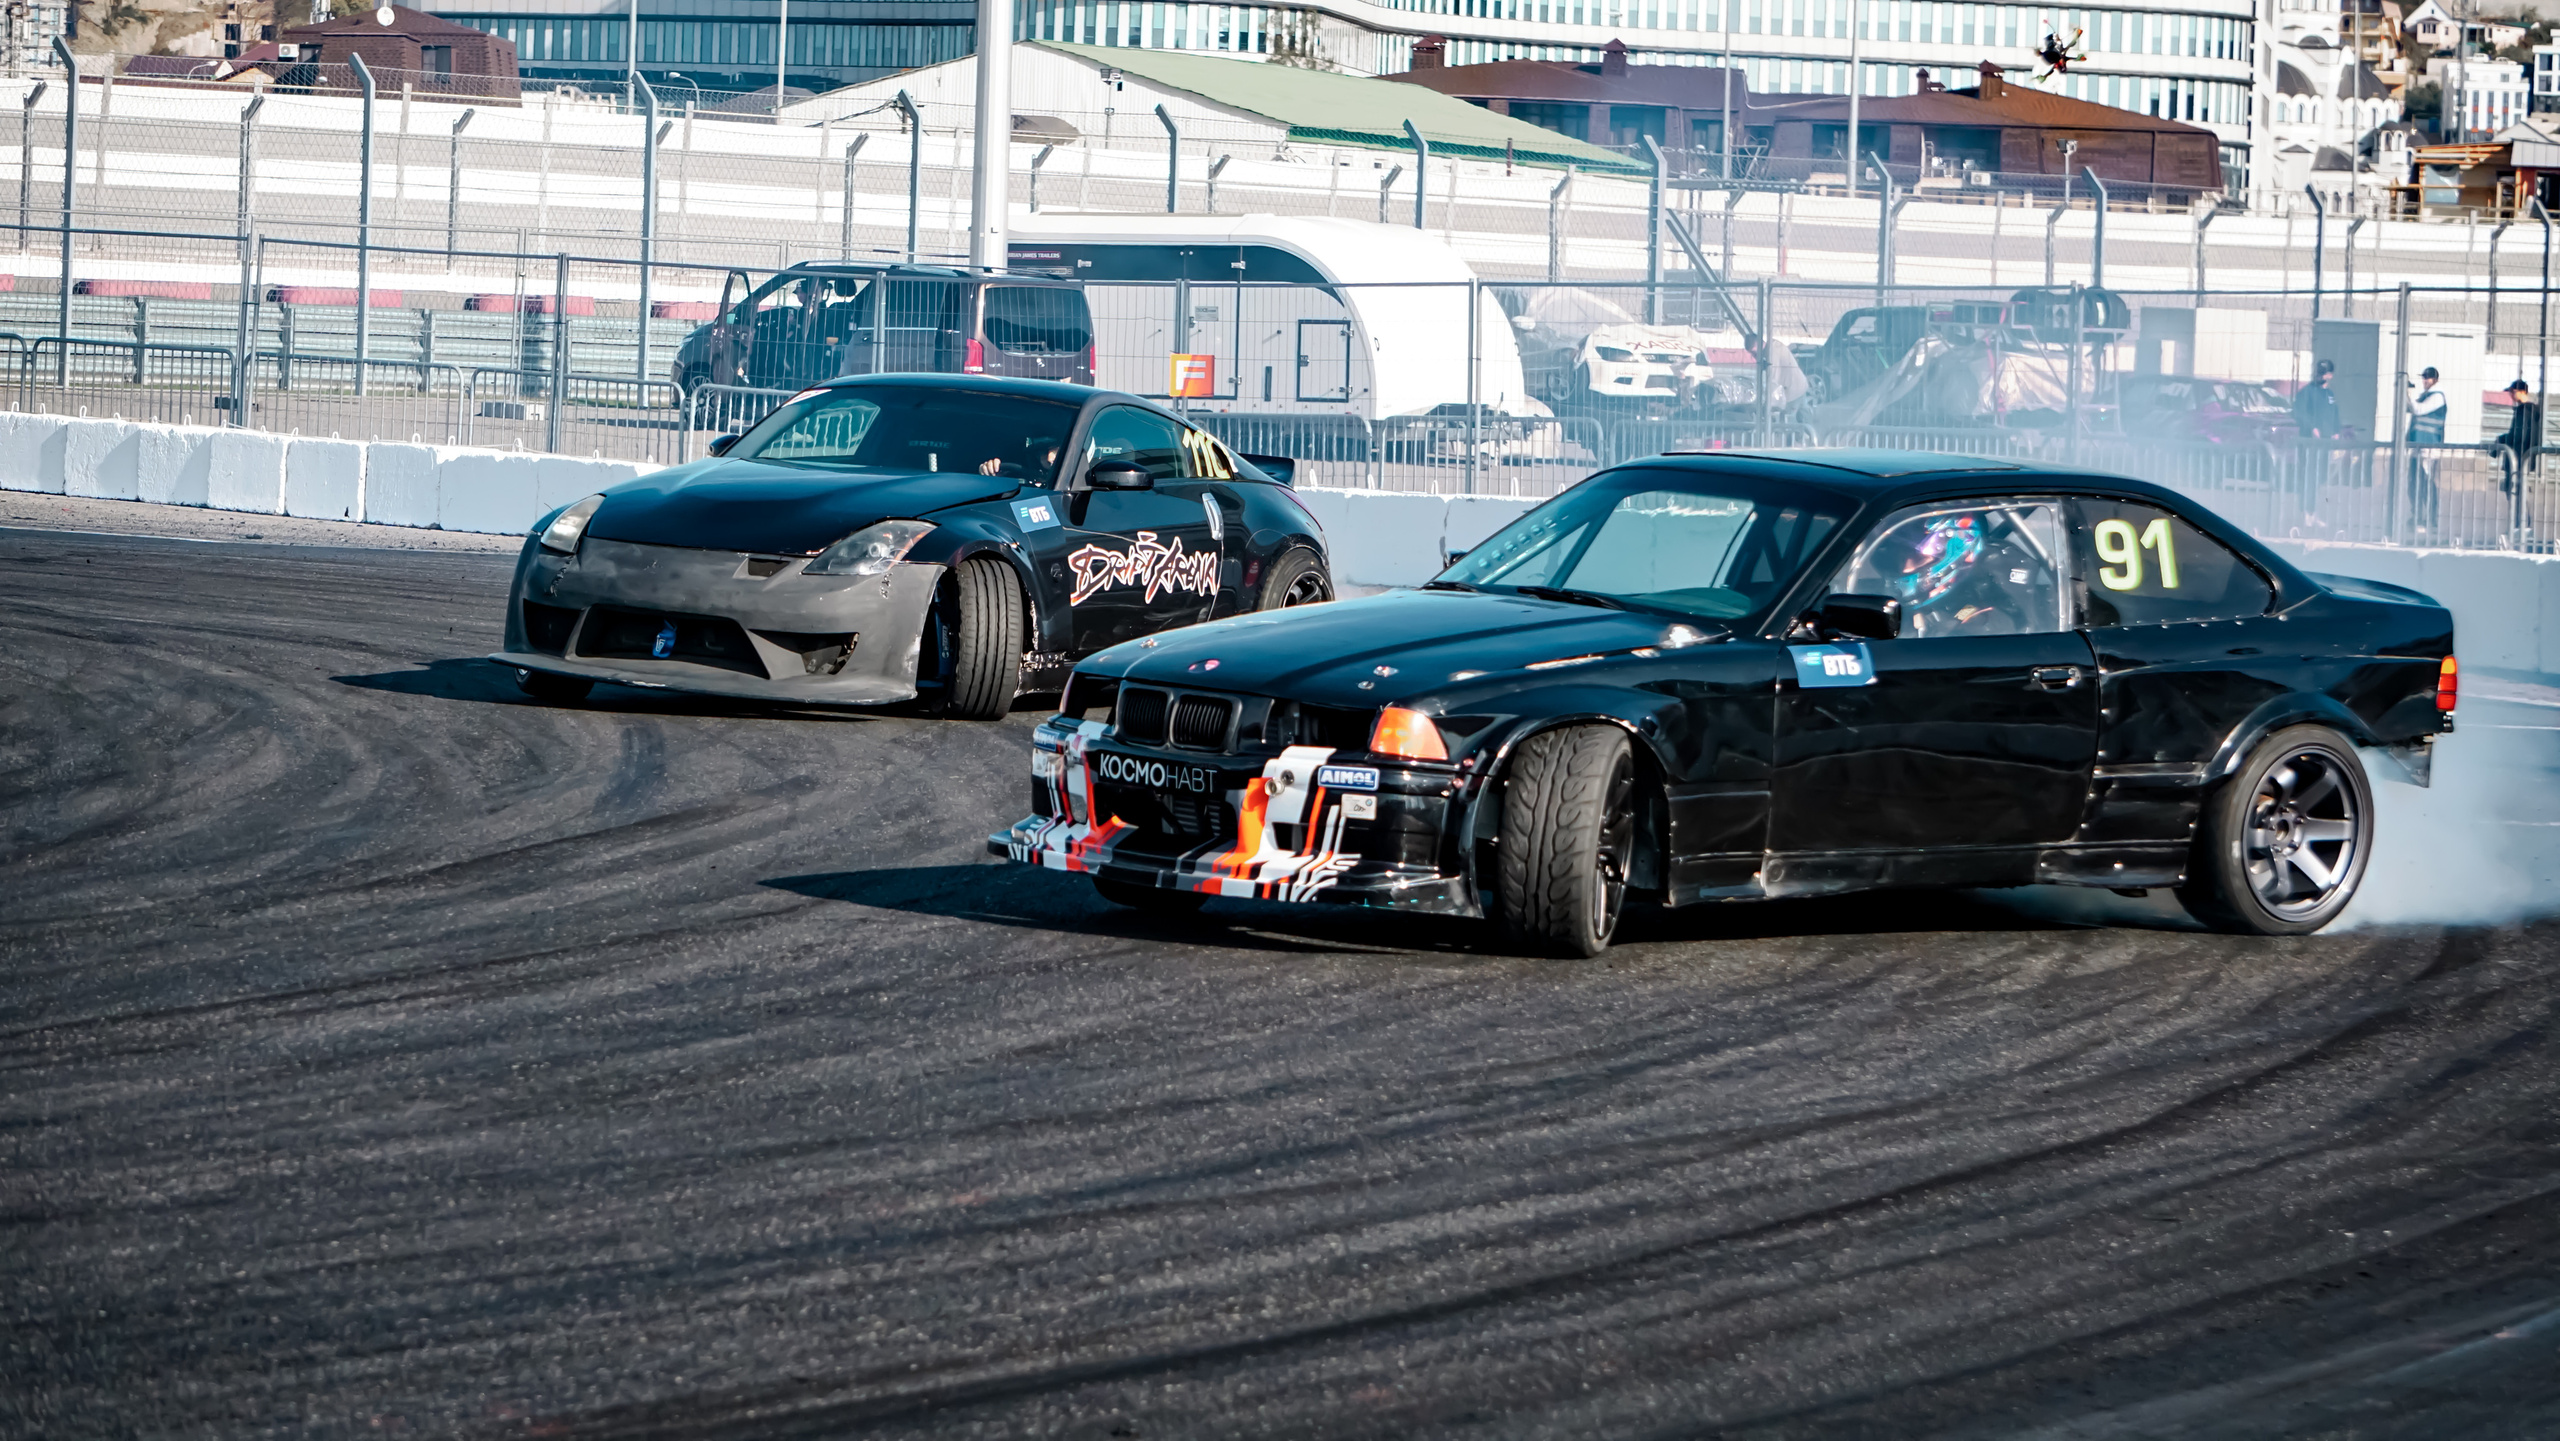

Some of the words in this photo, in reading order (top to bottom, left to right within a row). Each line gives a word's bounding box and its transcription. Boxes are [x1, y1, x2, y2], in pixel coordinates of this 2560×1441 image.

[1175, 360, 1206, 390] F
[1028, 505, 1051, 523] ВТБ
[2094, 518, 2179, 591] 91
[1822, 654, 1862, 676] ВТБ
[1099, 753, 1218, 793] КОСМОНАВТ
[1320, 769, 1375, 786] AIMOL
